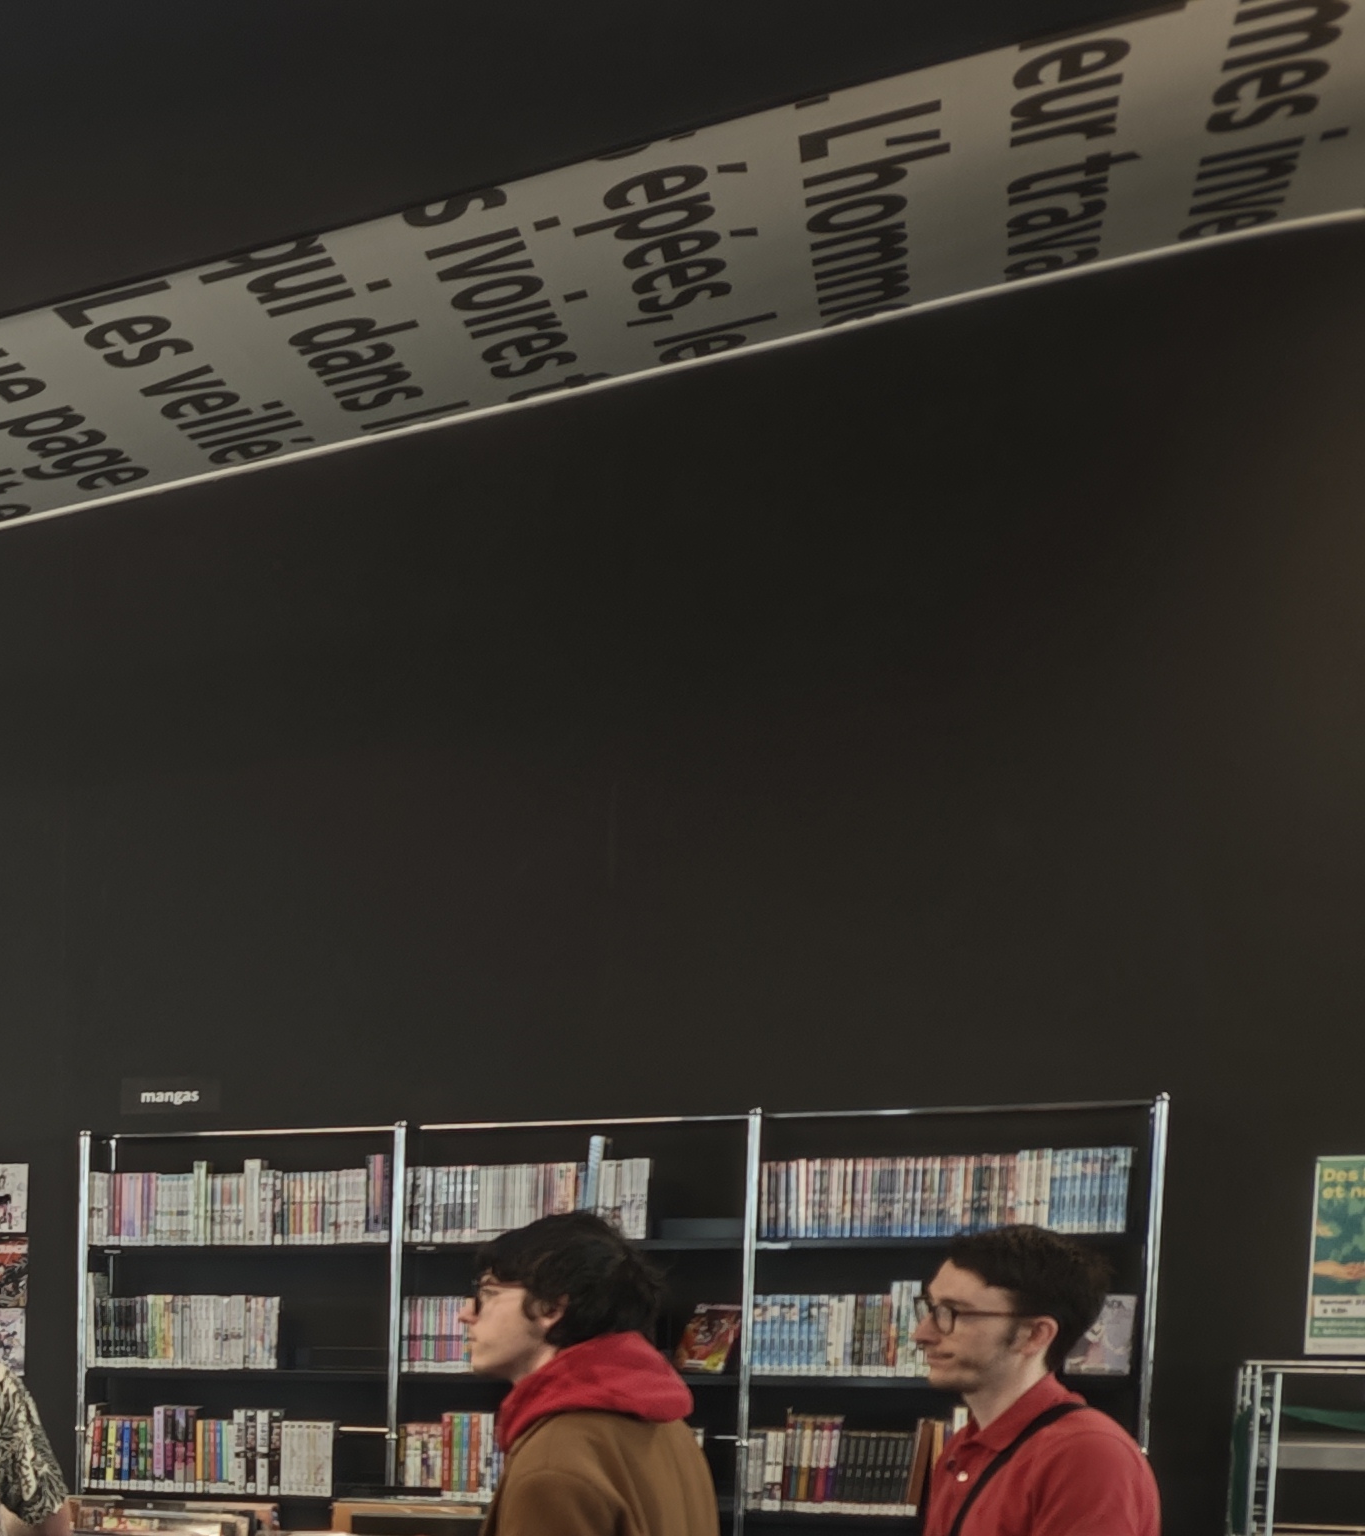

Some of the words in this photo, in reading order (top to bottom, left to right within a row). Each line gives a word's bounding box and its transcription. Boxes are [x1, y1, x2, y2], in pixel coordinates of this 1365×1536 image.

[51, 279, 195, 369] Les
[423, 217, 588, 379] ivoires
[288, 316, 425, 413] dans
[140, 1088, 200, 1106] mangas
[1322, 1168, 1359, 1183] Des
[1322, 1186, 1346, 1199] et
